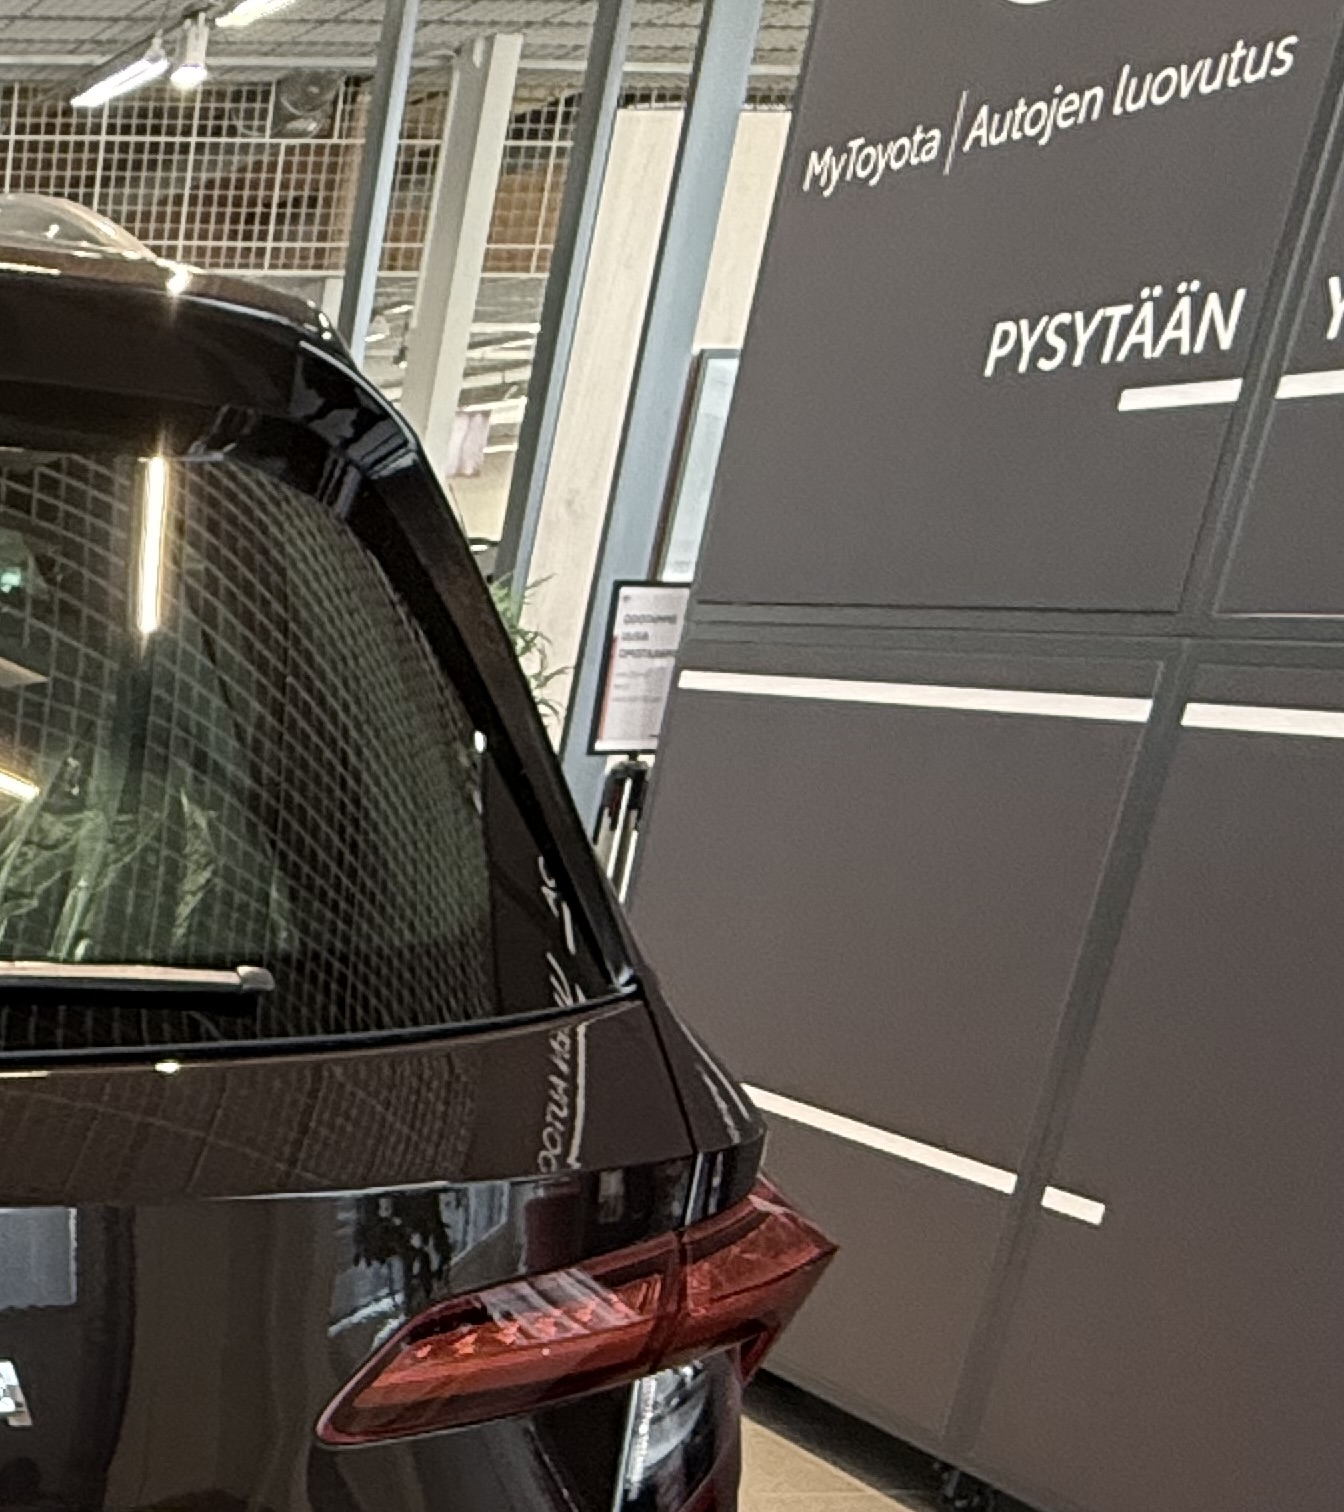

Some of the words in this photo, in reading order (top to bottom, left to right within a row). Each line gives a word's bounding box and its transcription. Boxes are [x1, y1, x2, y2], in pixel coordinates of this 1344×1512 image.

[803, 124, 941, 198] MyToyota
[962, 84, 1104, 147] Autojen
[1112, 33, 1300, 116] luovutus
[983, 278, 1248, 378] PYSYTÄÄN
